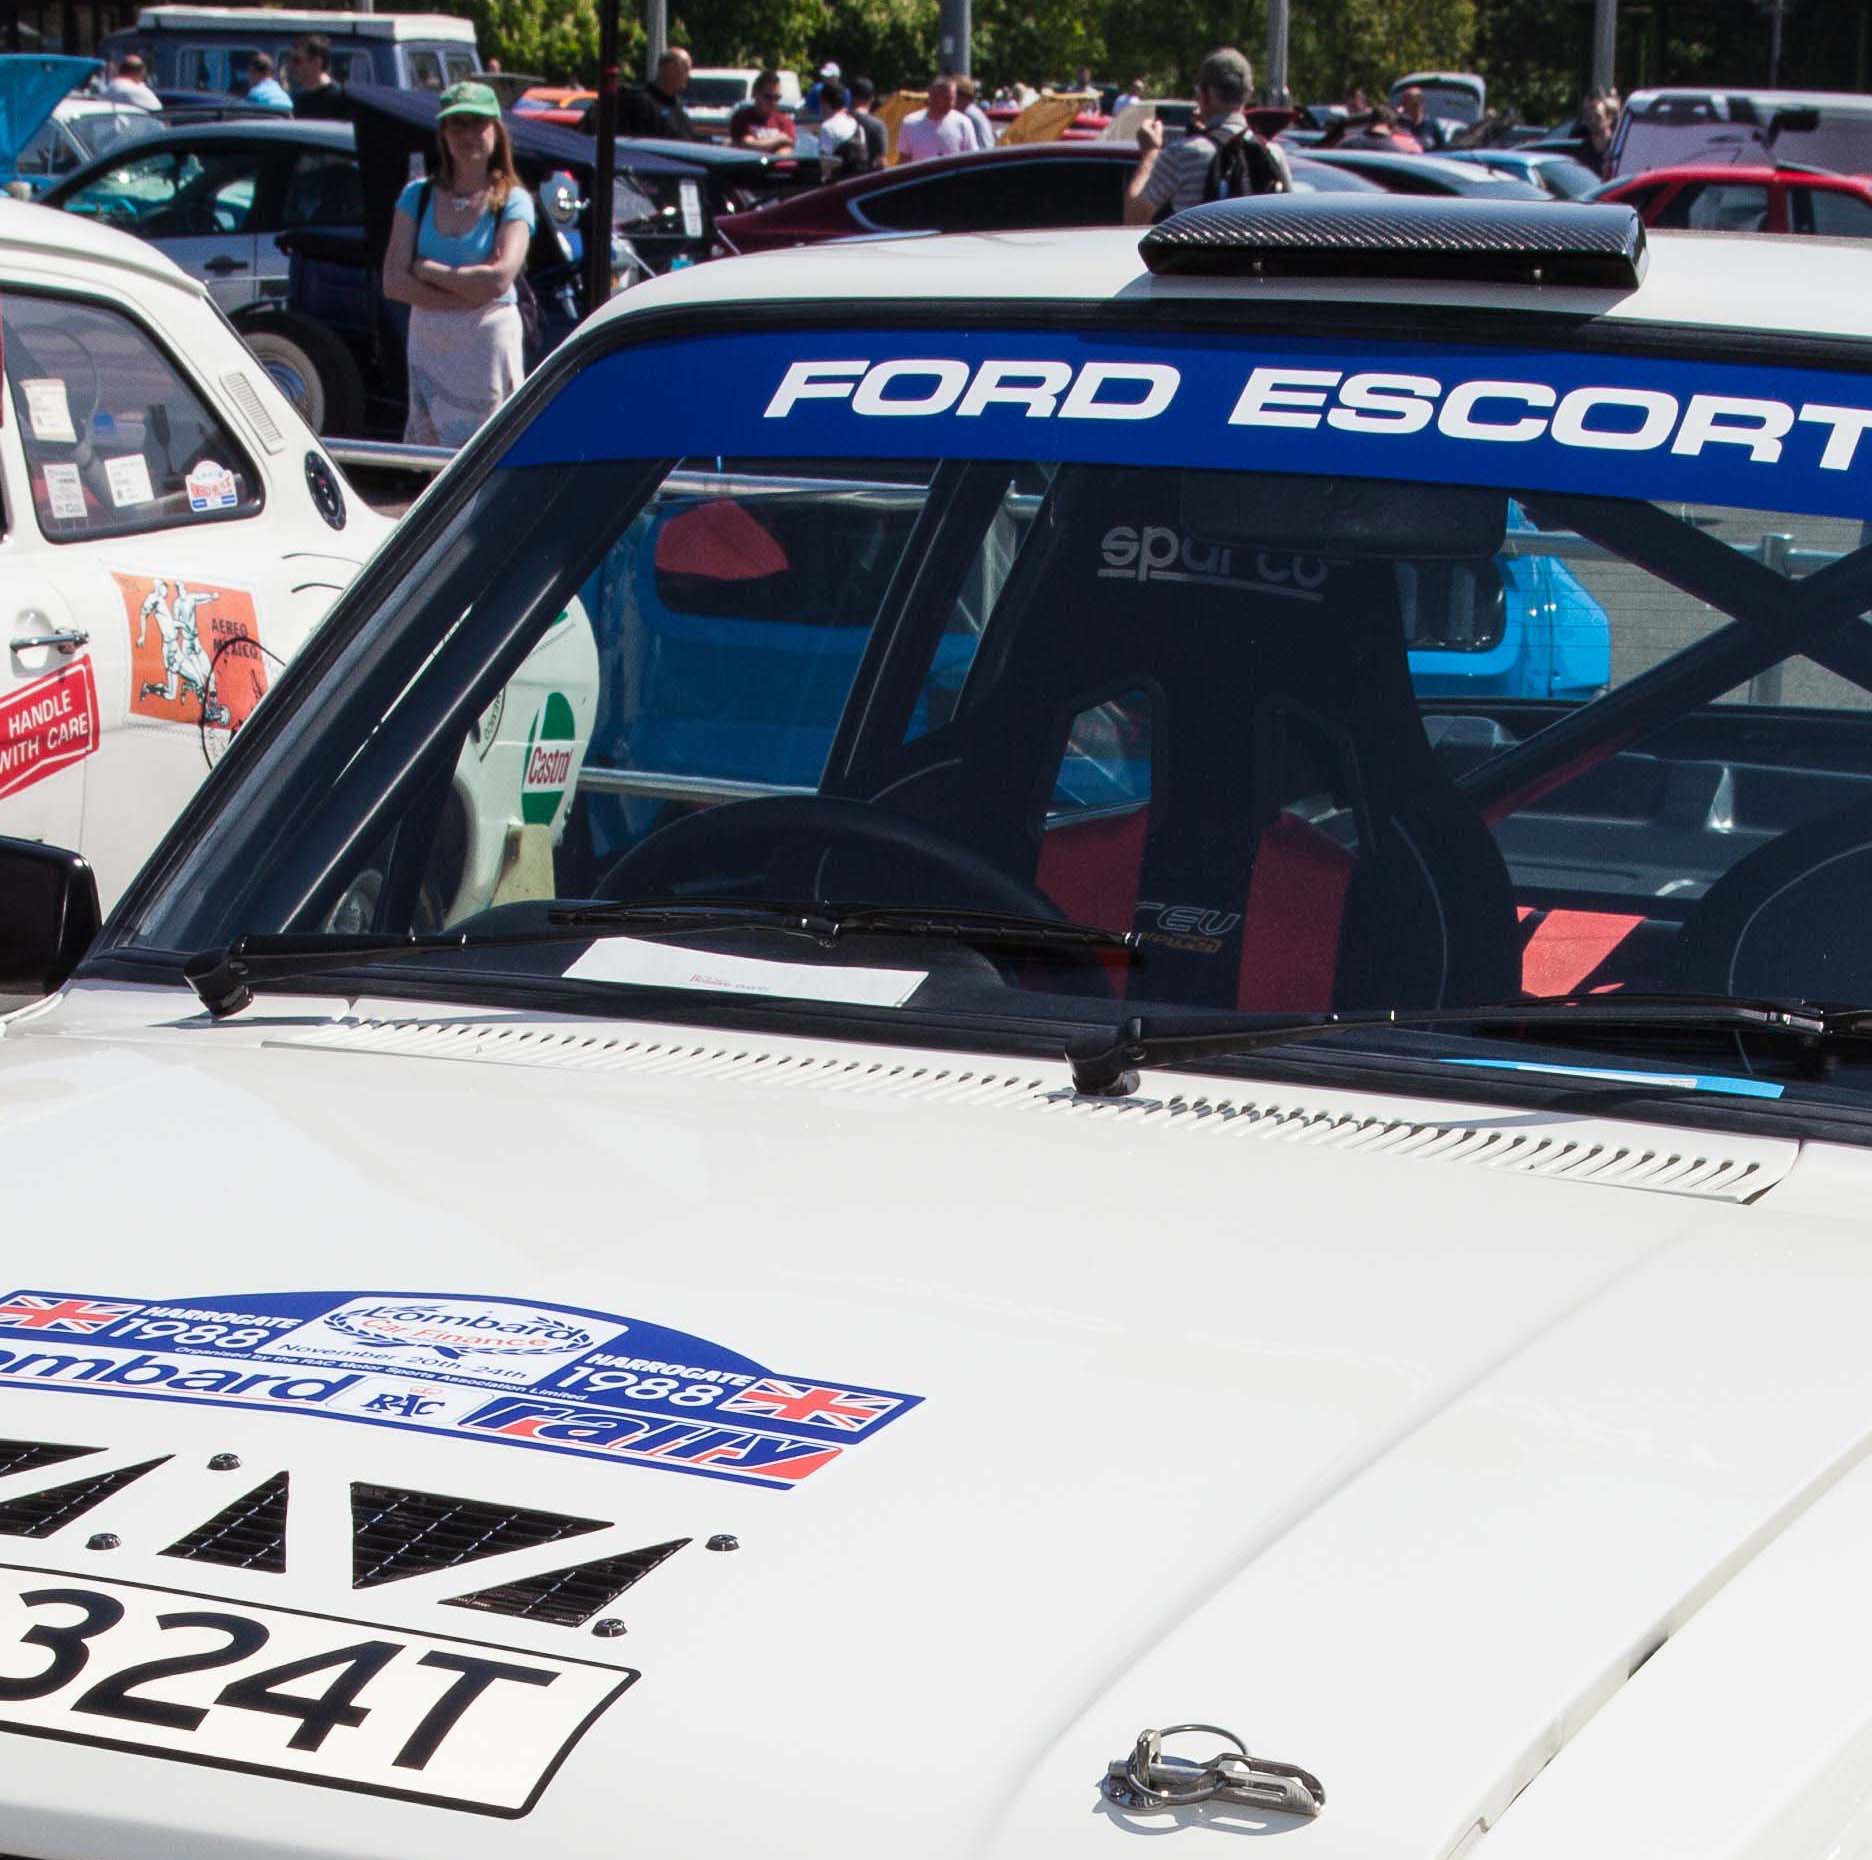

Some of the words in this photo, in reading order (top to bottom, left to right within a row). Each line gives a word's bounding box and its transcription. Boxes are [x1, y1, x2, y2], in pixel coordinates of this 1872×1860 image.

[763, 358, 1181, 421] FORD
[7, 688, 74, 739] HANDLE
[47, 712, 90, 750] CARE
[109, 1317, 270, 1349] 1988
[139, 1305, 304, 1330] HARROGATE
[360, 1305, 587, 1342] Lombard
[362, 1317, 410, 1337] Car
[412, 1327, 551, 1348] Finance
[279, 1343, 396, 1362] November
[584, 1352, 757, 1388] HARROGATE
[174, 1346, 254, 1361] Organised
[275, 1354, 298, 1364] the
[300, 1356, 335, 1368] RAC
[339, 1361, 384, 1372] Motor
[384, 1366, 437, 1379] Sports
[437, 1373, 528, 1393] Association
[529, 1385, 588, 1402] Limited
[556, 1365, 725, 1408] 1988
[360, 1392, 446, 1418] RAC
[463, 1399, 841, 1471] rally
